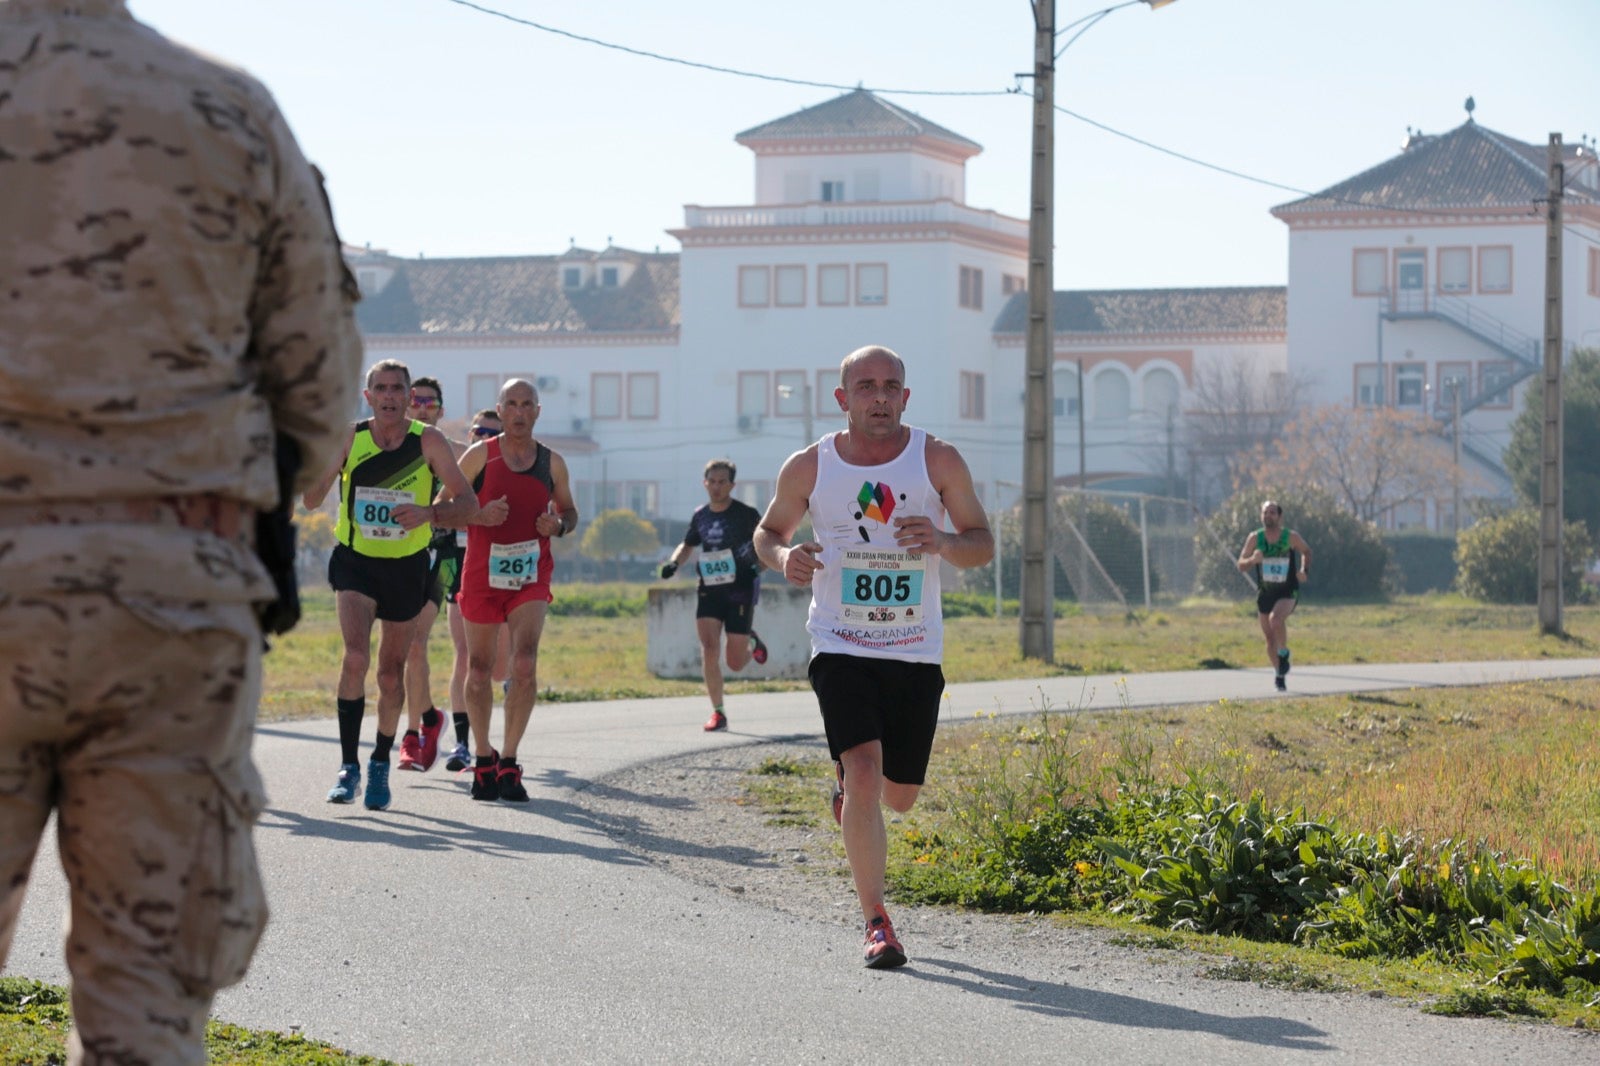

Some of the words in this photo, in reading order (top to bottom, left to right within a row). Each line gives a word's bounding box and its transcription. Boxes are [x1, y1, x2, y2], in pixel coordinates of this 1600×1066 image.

[862, 552, 876, 560] GRAN
[877, 553, 896, 561] PREMIO
[499, 556, 533, 574] 261
[705, 561, 729, 575] 849
[855, 574, 911, 601] 805
